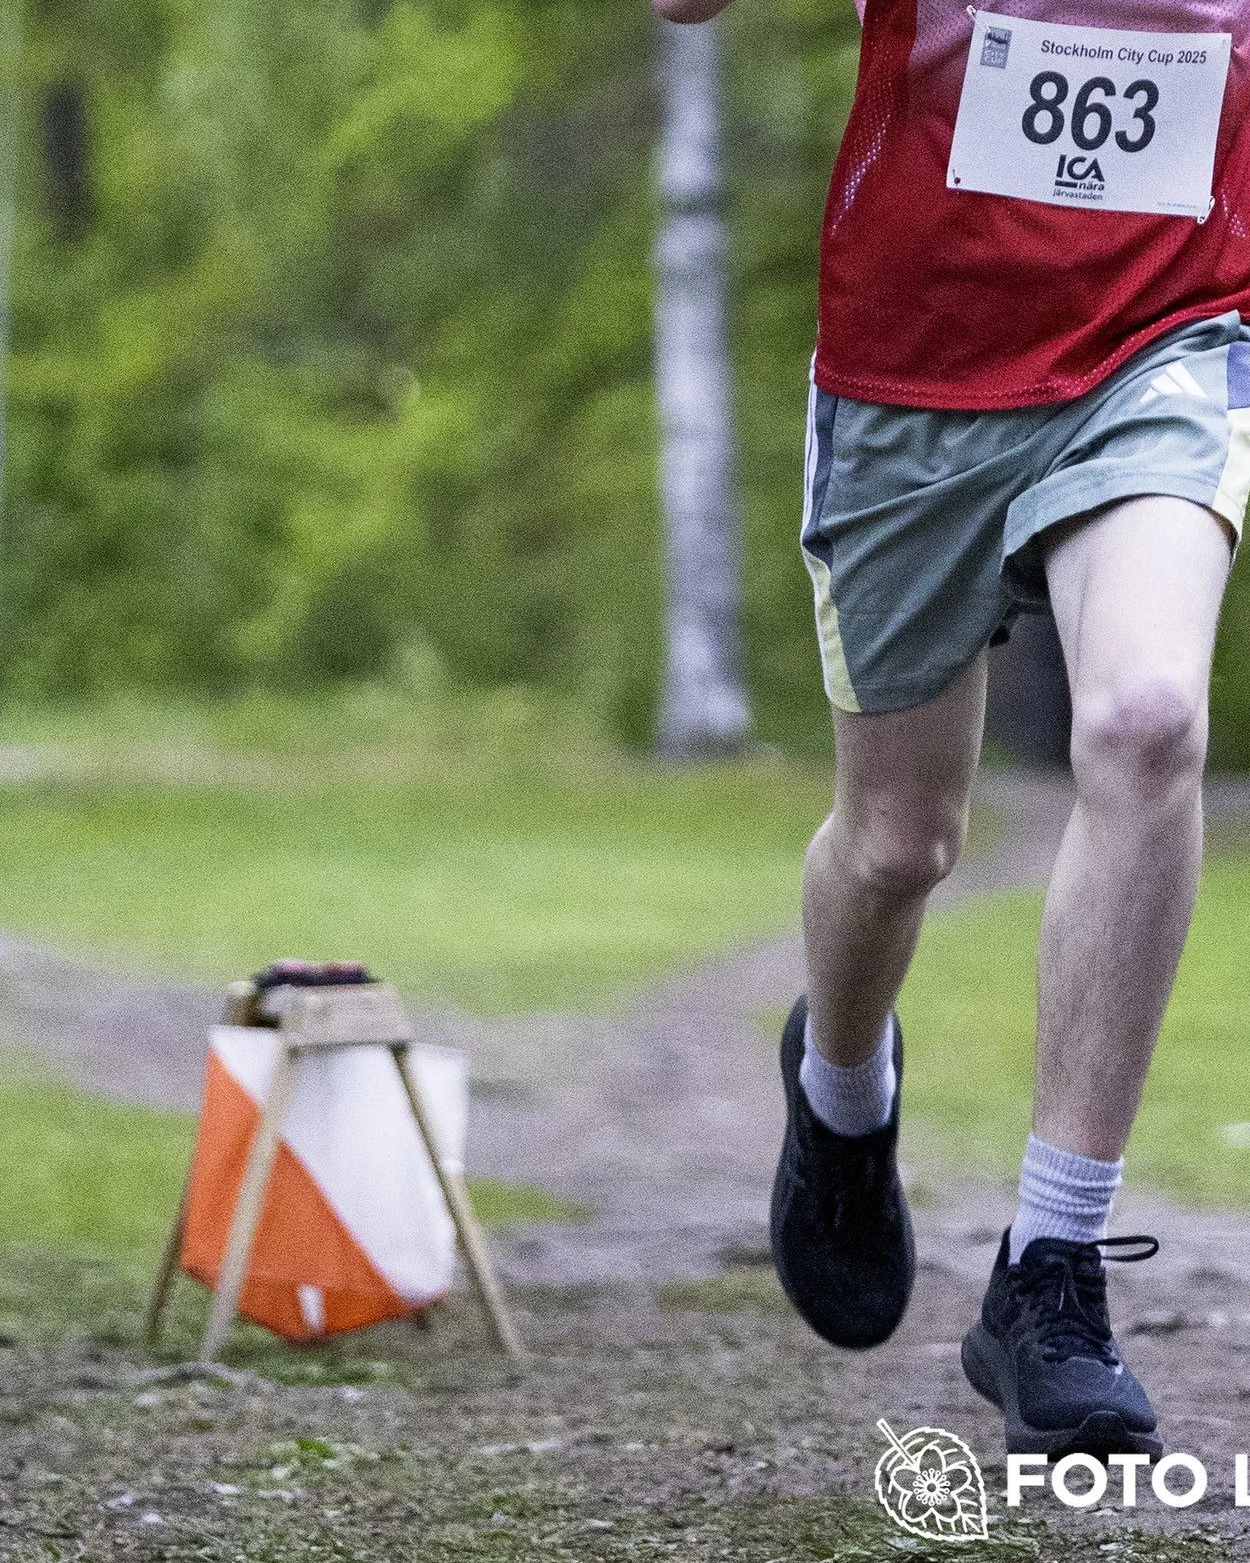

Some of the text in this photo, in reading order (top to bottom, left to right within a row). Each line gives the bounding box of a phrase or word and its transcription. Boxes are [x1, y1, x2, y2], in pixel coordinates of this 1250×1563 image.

[1041, 39, 1207, 66] Stockholm City Cup 2025
[1021, 70, 1159, 153] 863
[1056, 154, 1105, 182] ICA
[1078, 180, 1105, 191] nära
